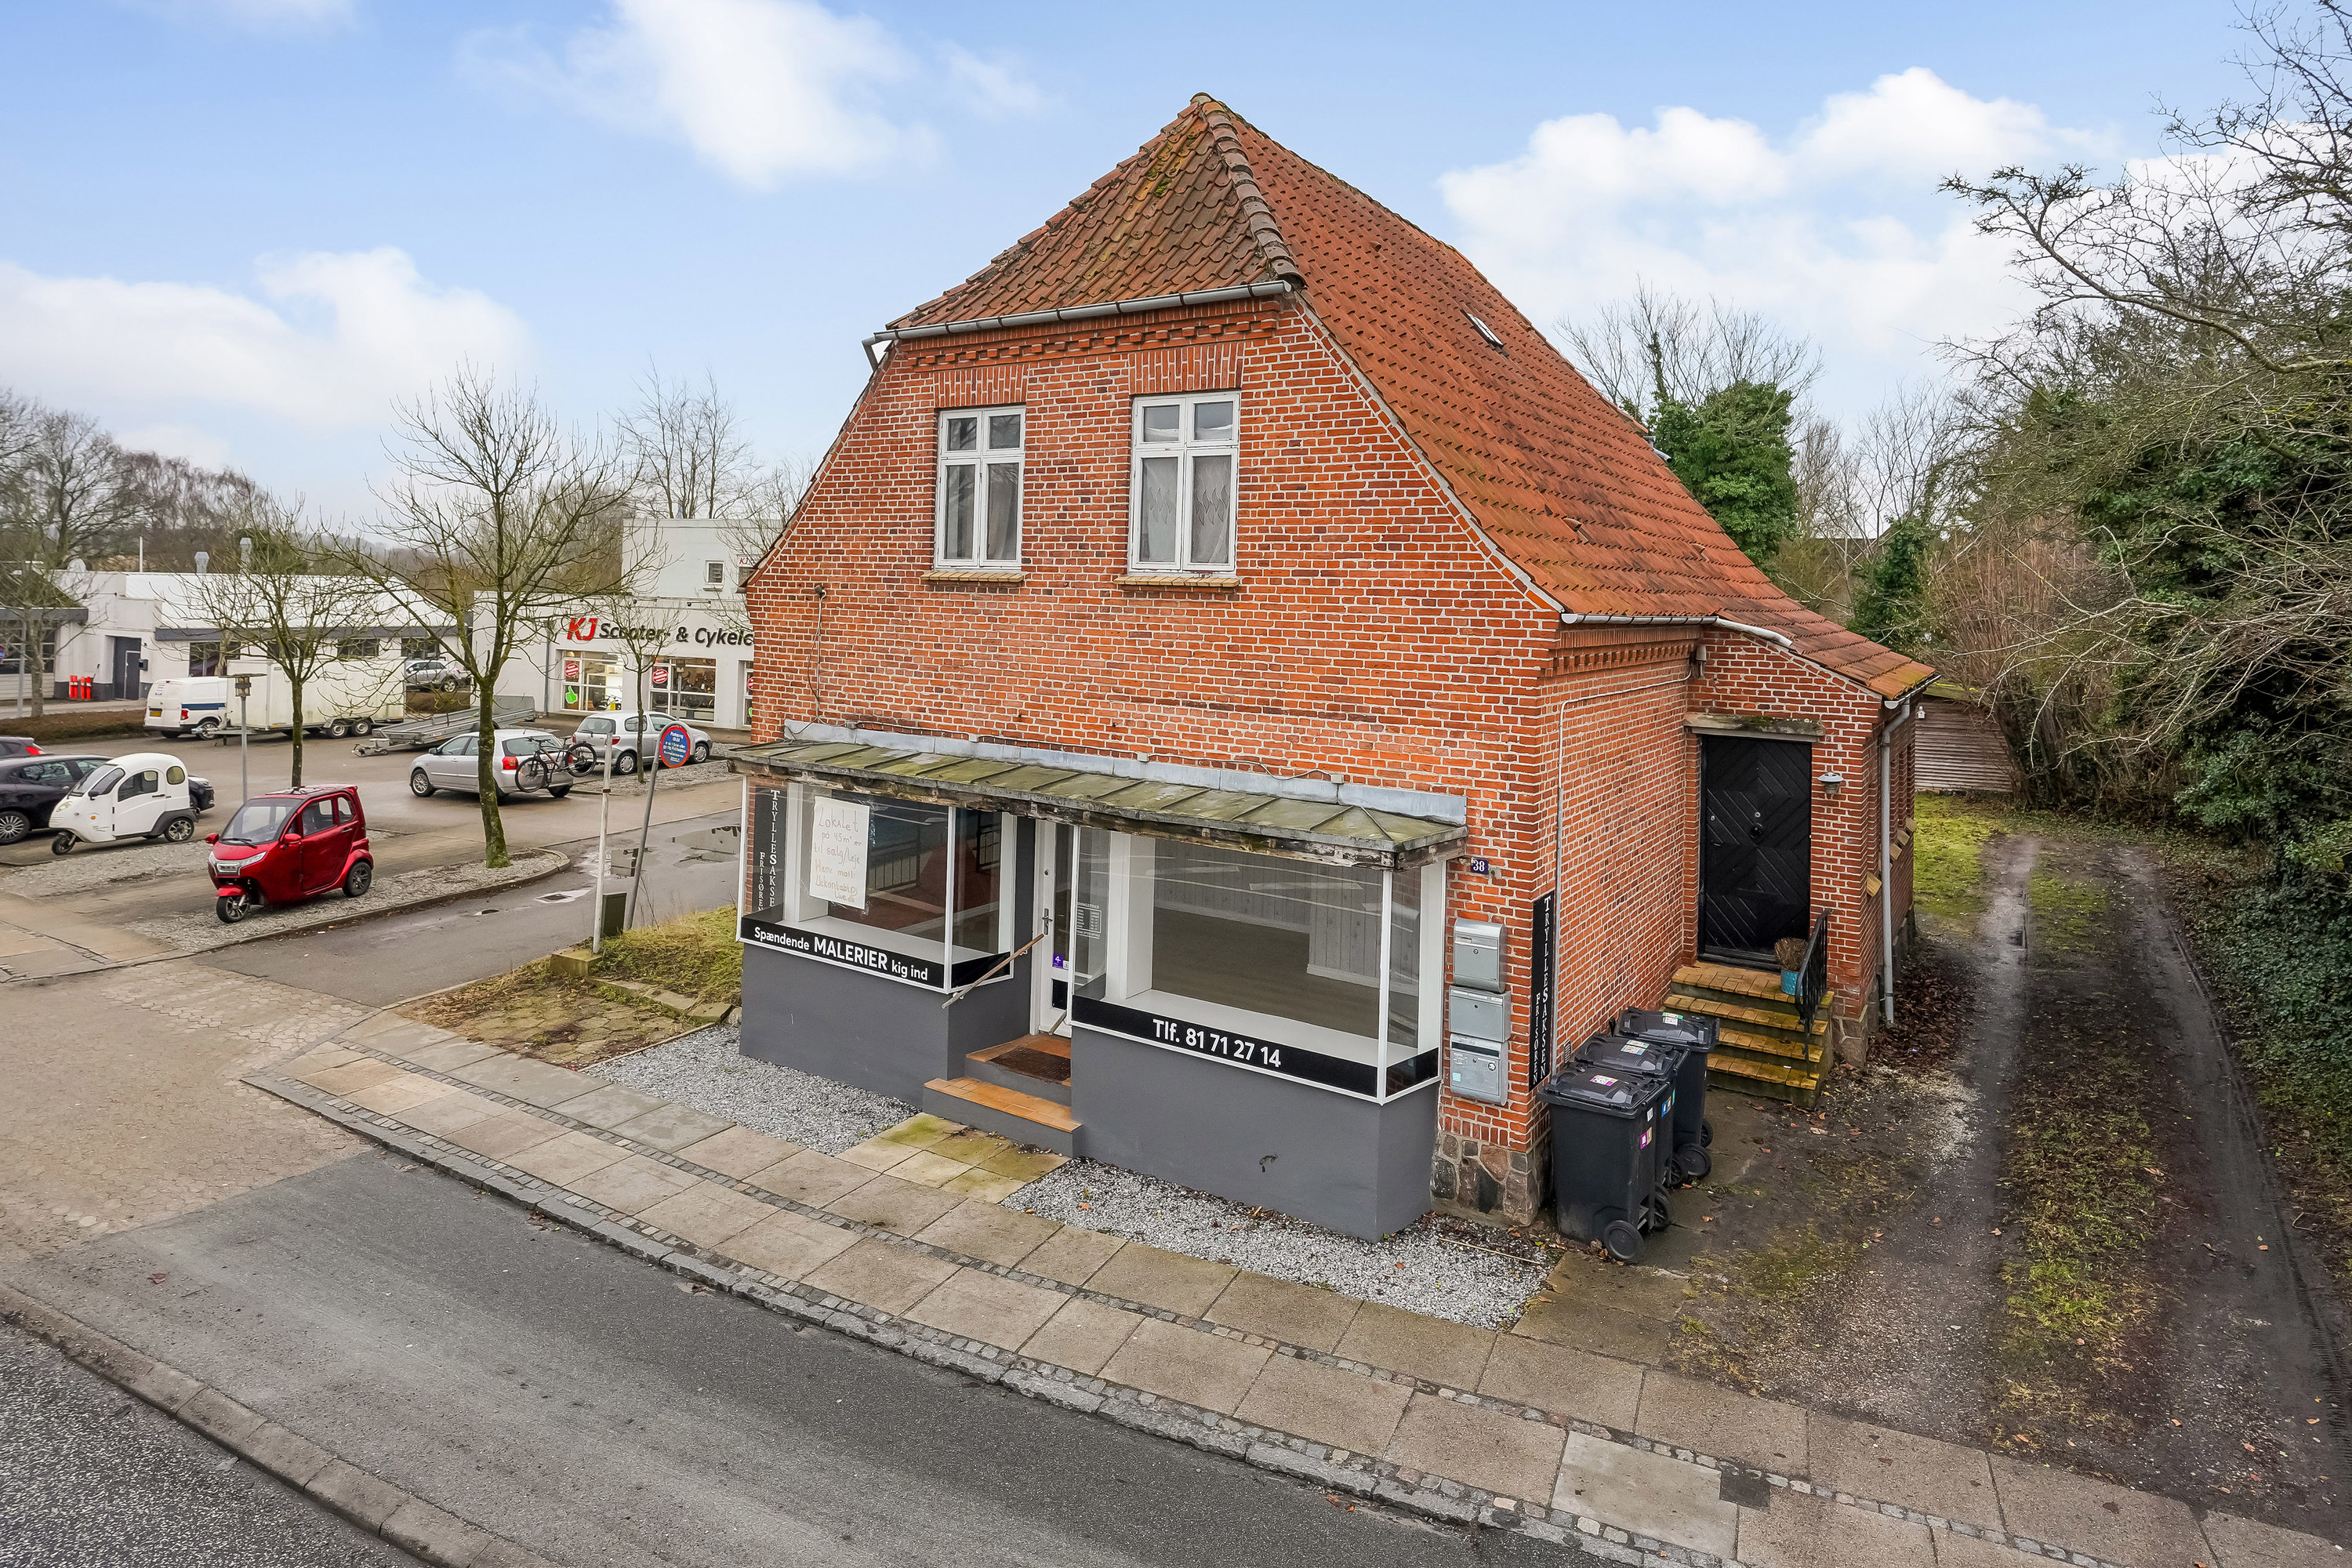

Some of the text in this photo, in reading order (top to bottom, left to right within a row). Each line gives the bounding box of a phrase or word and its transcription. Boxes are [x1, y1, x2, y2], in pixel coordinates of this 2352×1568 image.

[567, 617, 597, 641] KJ
[676, 626, 689, 643] &
[814, 842, 823, 853] til
[1473, 860, 1485, 872] 38
[754, 926, 928, 981] Spændende MALERIER kig ind
[1540, 895, 1552, 1080] TRYLLESAKSEN
[1152, 1018, 1281, 1068] Tlf. 81 71 27 14
